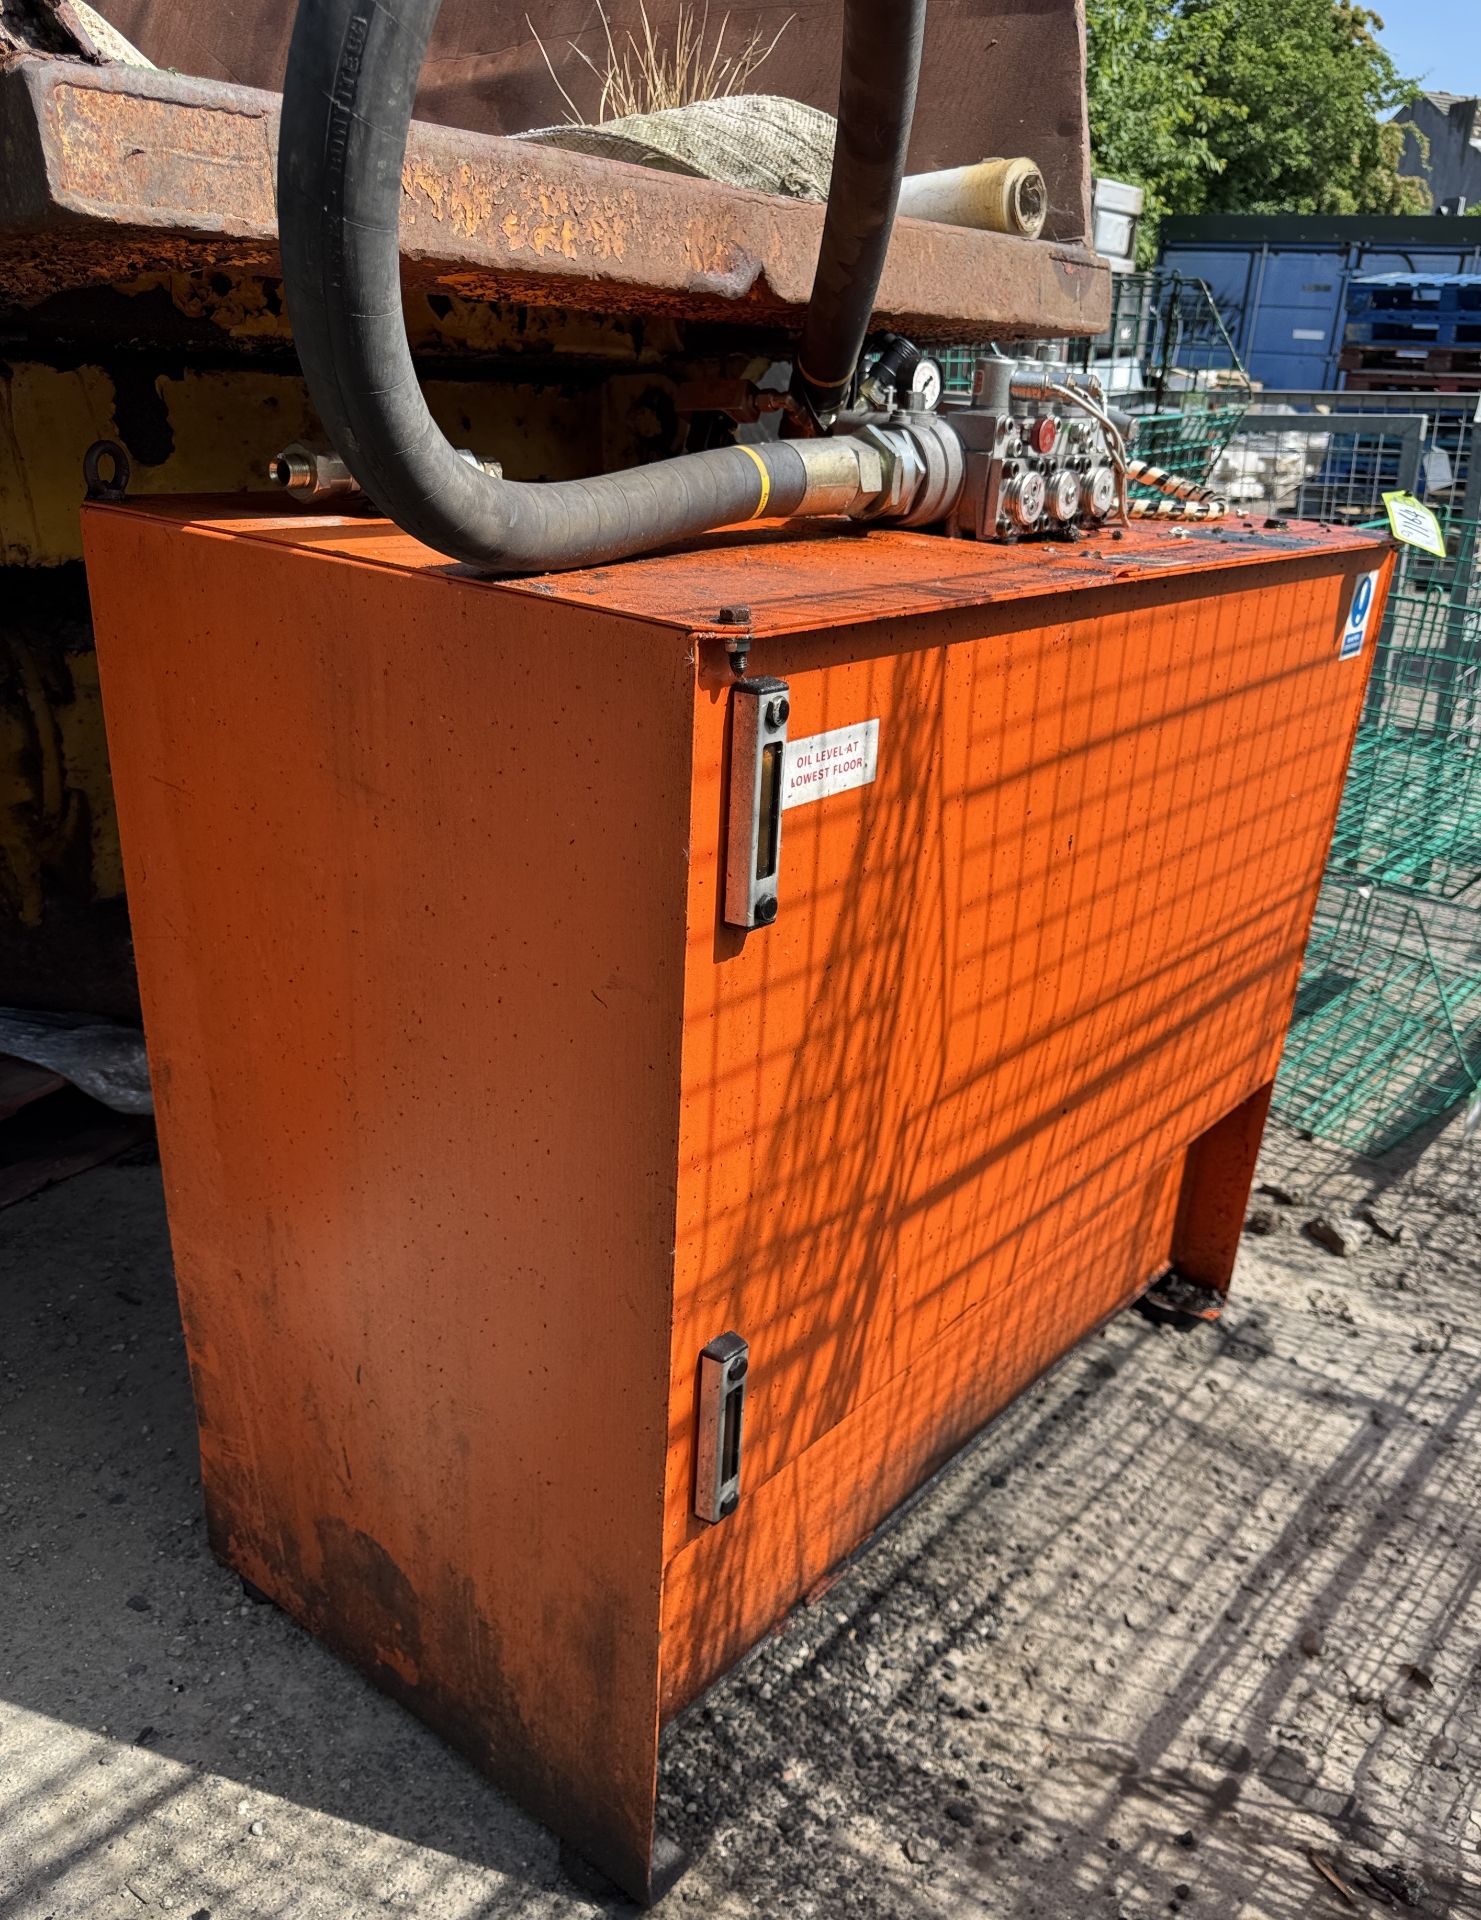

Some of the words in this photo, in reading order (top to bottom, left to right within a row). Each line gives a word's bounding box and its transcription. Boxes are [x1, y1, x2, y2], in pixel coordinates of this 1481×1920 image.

[797, 755, 812, 768] OIL
[816, 745, 843, 762] LEVEL
[846, 741, 859, 753] AT
[791, 768, 829, 788] LOWEST
[833, 757, 863, 776] FLOOR
